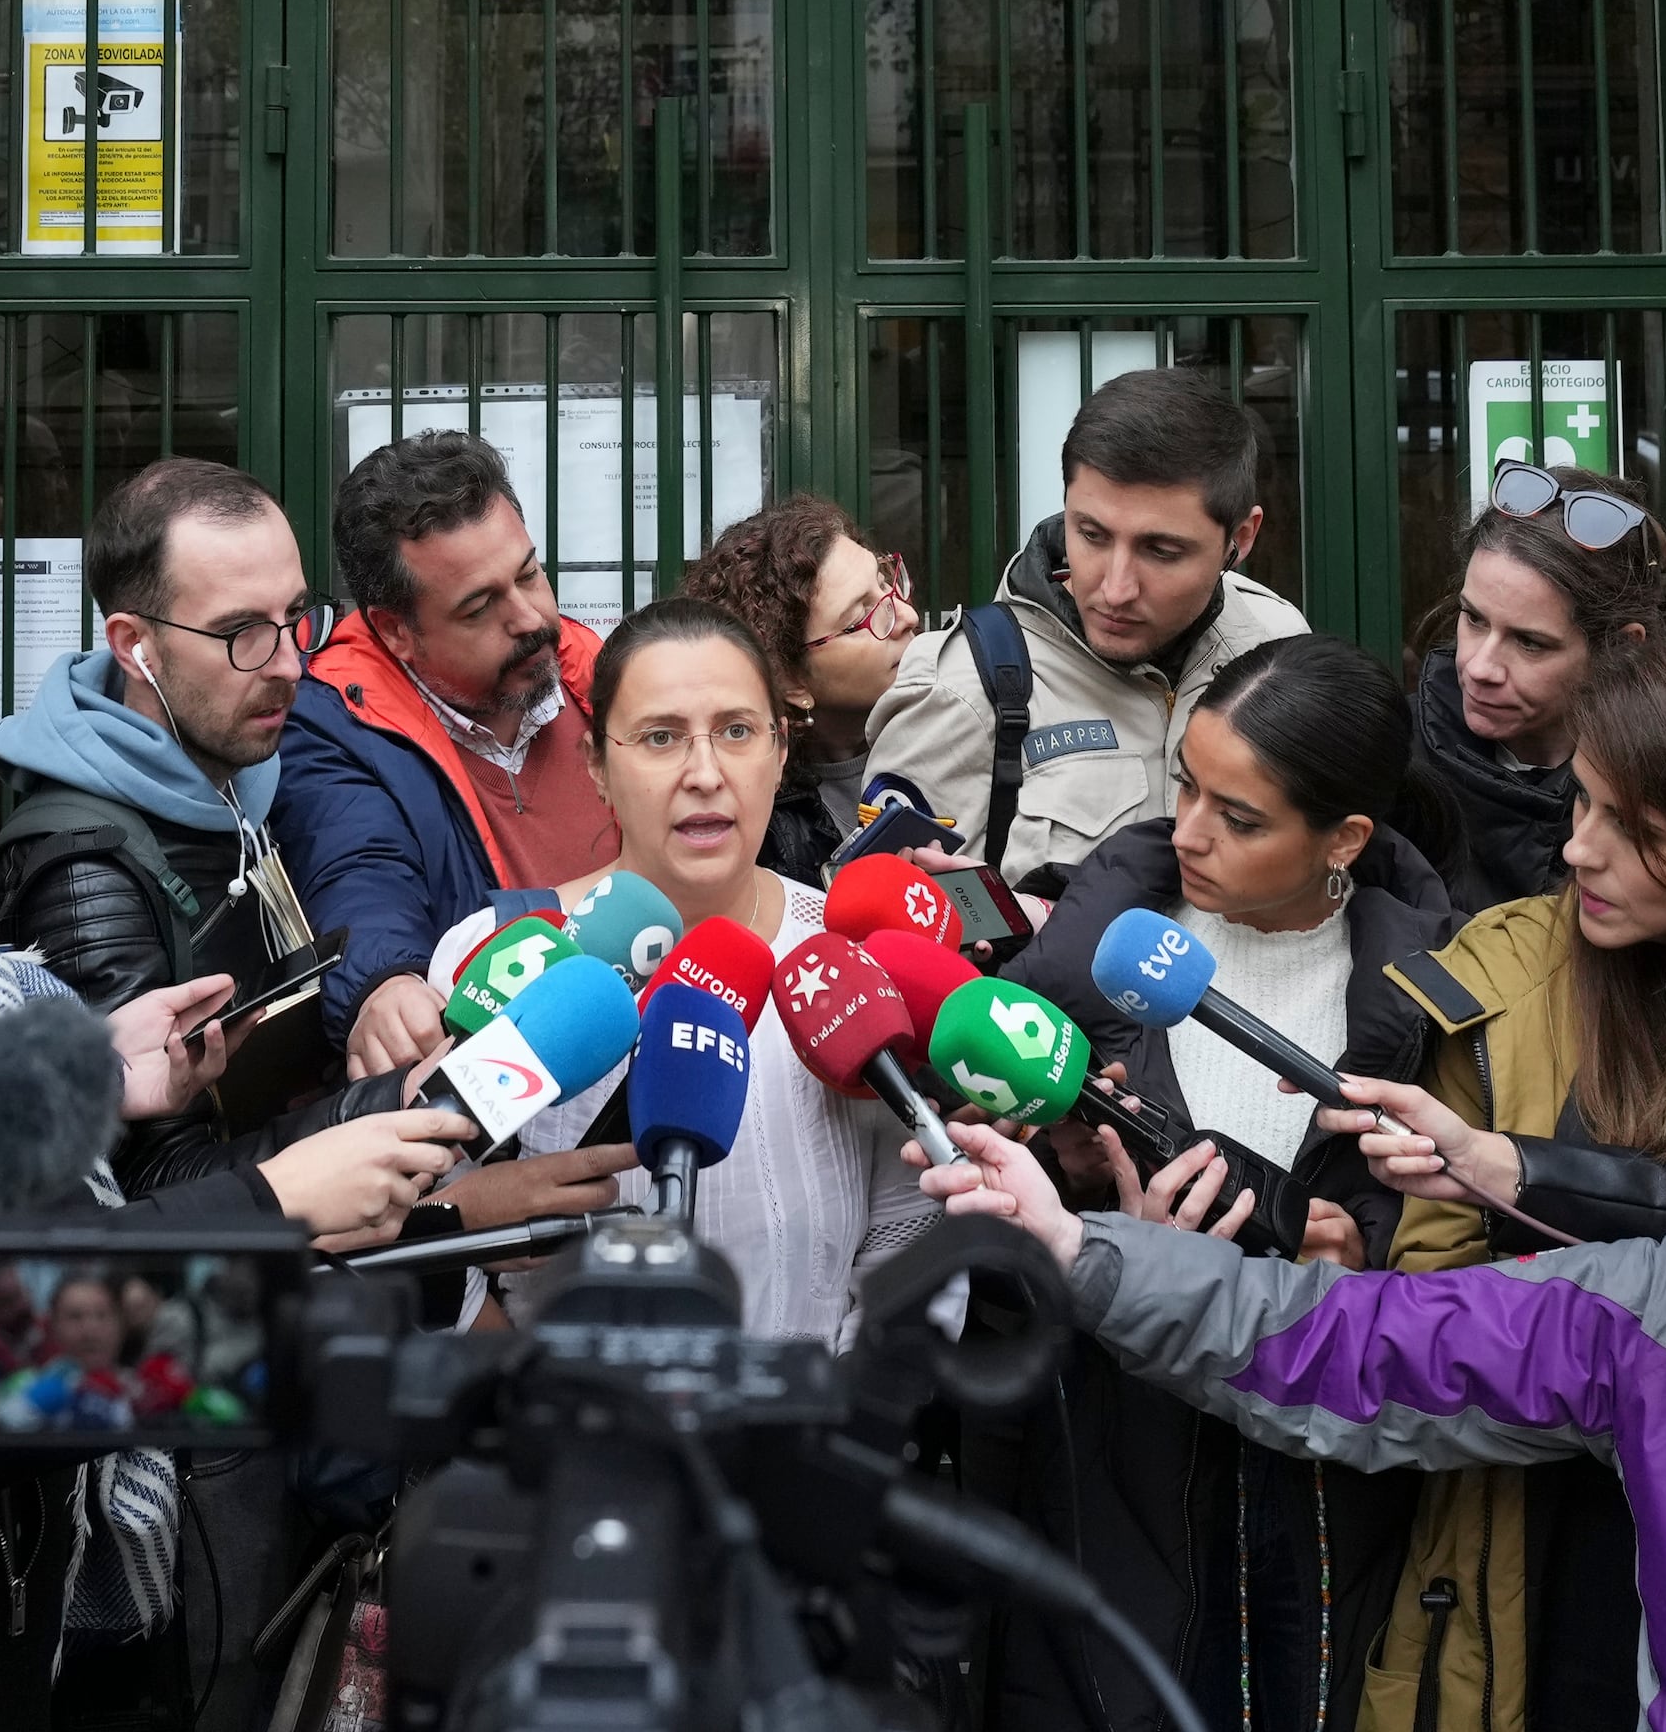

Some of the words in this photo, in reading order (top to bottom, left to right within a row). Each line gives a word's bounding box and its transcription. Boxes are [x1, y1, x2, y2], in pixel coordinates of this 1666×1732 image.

[46, 8, 86, 17] AUTORIZAD
[44, 48, 75, 60] ZONA
[78, 48, 163, 60] VEOVIGILADA
[1520, 364, 1571, 376] ESACIO
[1486, 377, 1606, 389] CARDIOROTEGIDO
[579, 441, 622, 450] CONSULTA
[633, 441, 656, 449] ROCE
[682, 439, 721, 448] LECTOS
[582, 618, 601, 626] CITA
[603, 618, 622, 626] PREV
[1034, 727, 1110, 754] HARPER
[560, 916, 581, 942] OPE
[1138, 929, 1190, 981] tve
[678, 957, 748, 1014] europa
[461, 980, 505, 1017] laSex
[1112, 990, 1149, 1015] ve
[1046, 1021, 1073, 1085] laSexta
[456, 1064, 510, 1127] ATLAS
